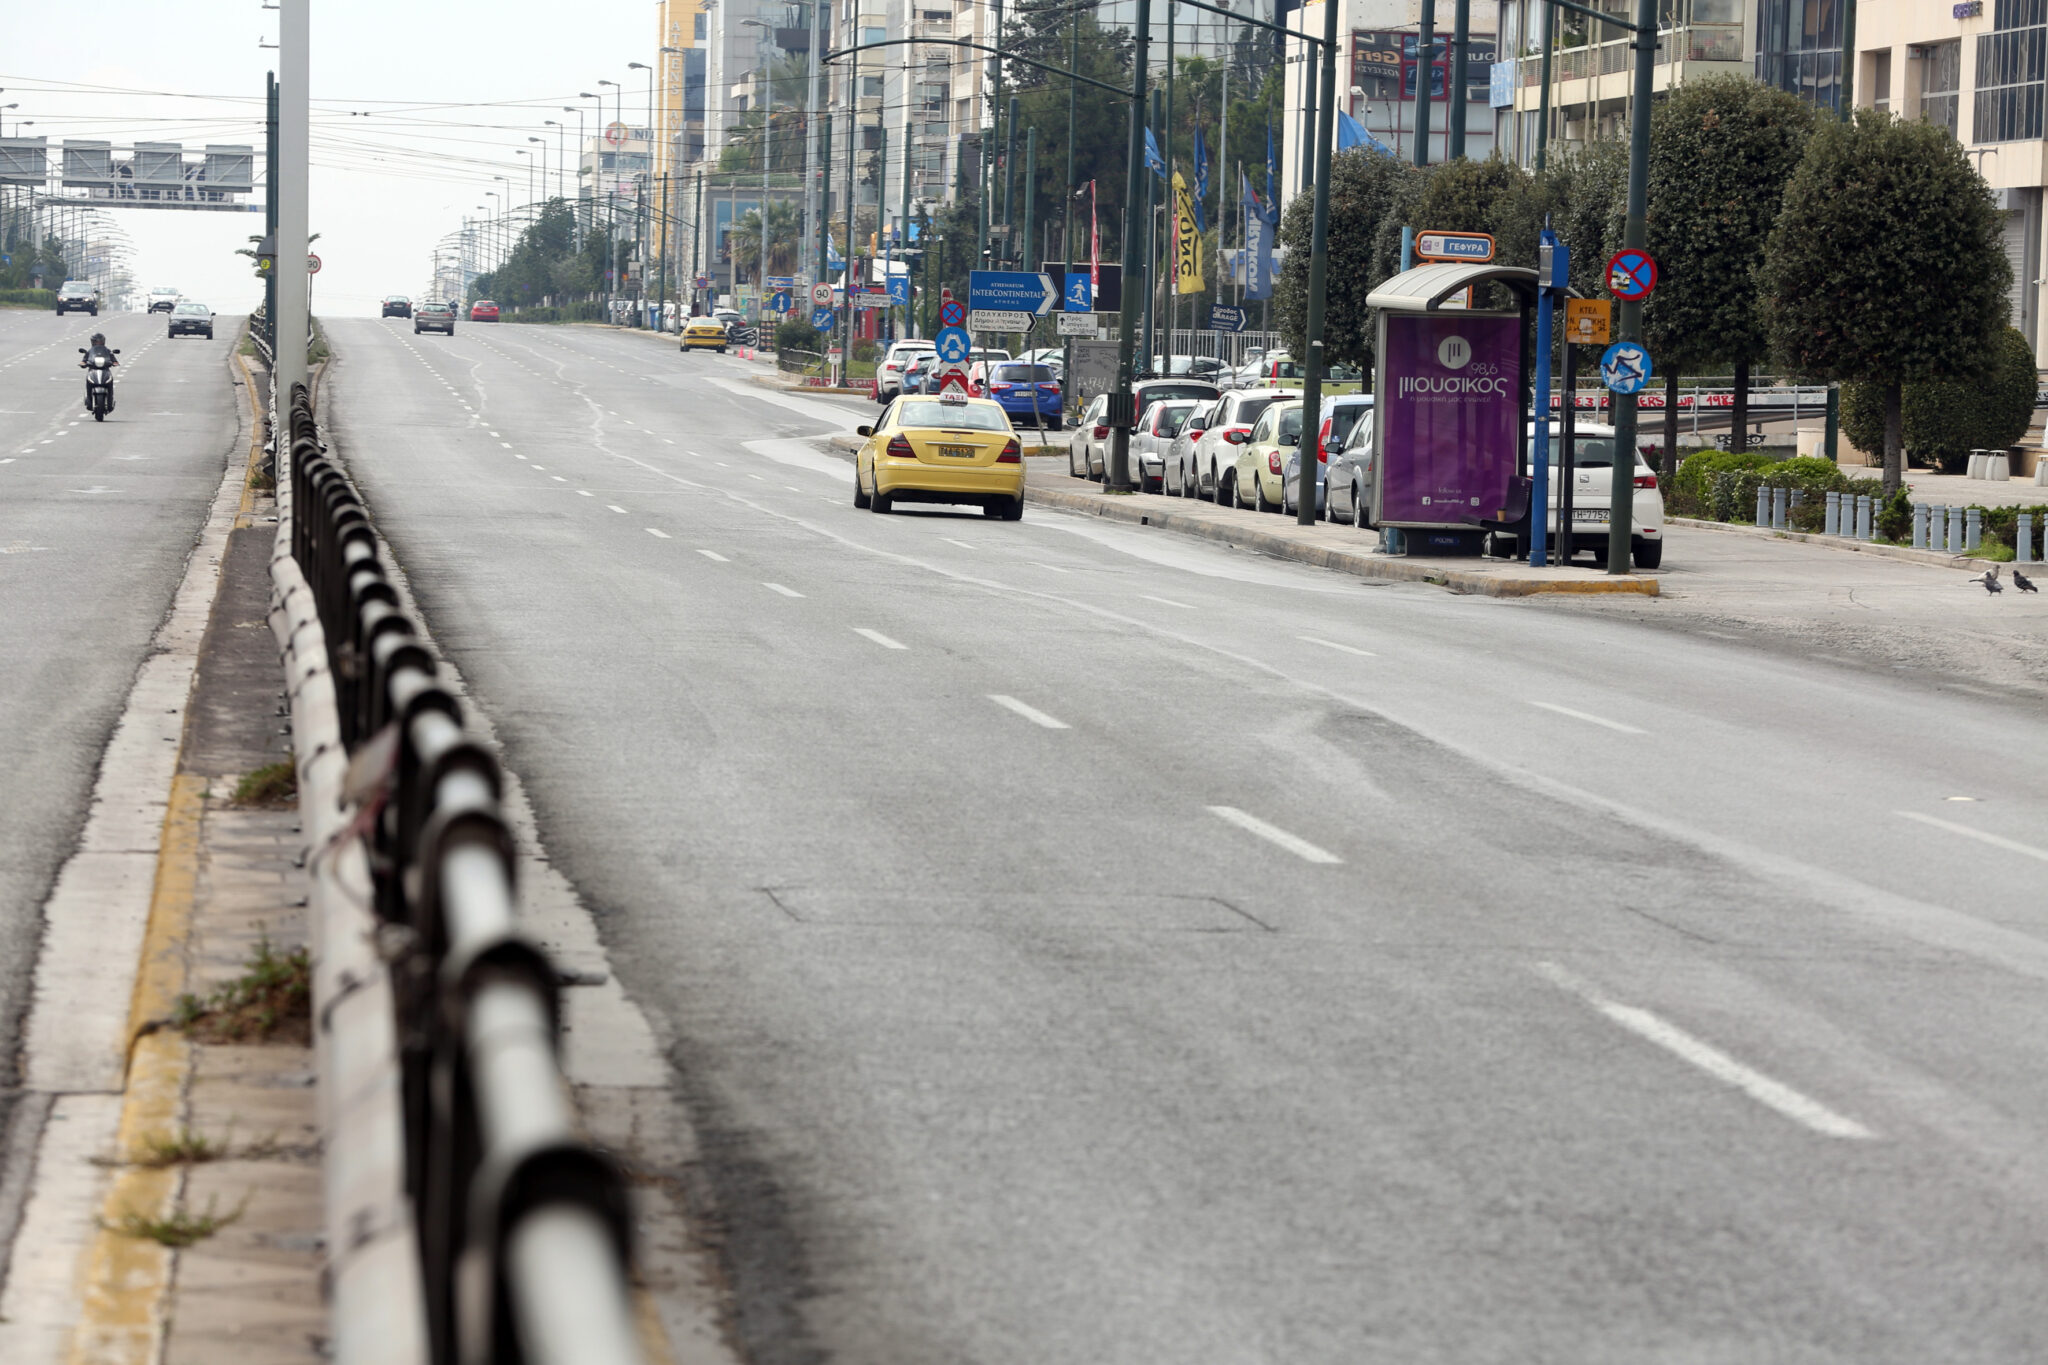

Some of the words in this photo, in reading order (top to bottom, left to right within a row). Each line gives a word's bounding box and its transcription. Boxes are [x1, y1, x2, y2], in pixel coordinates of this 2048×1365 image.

[670, 20, 681, 95] ATHENS
[1449, 242, 1484, 252] ΓΕΦΥΡΑ
[816, 289, 829, 299] 90
[974, 311, 1025, 319] ΠΟΛΥΧΩΡΟΣ
[1579, 306, 1597, 314] ΚΤΕΛ
[1470, 362, 1498, 375] 98,6
[1572, 510, 1609, 519] TH-7752
